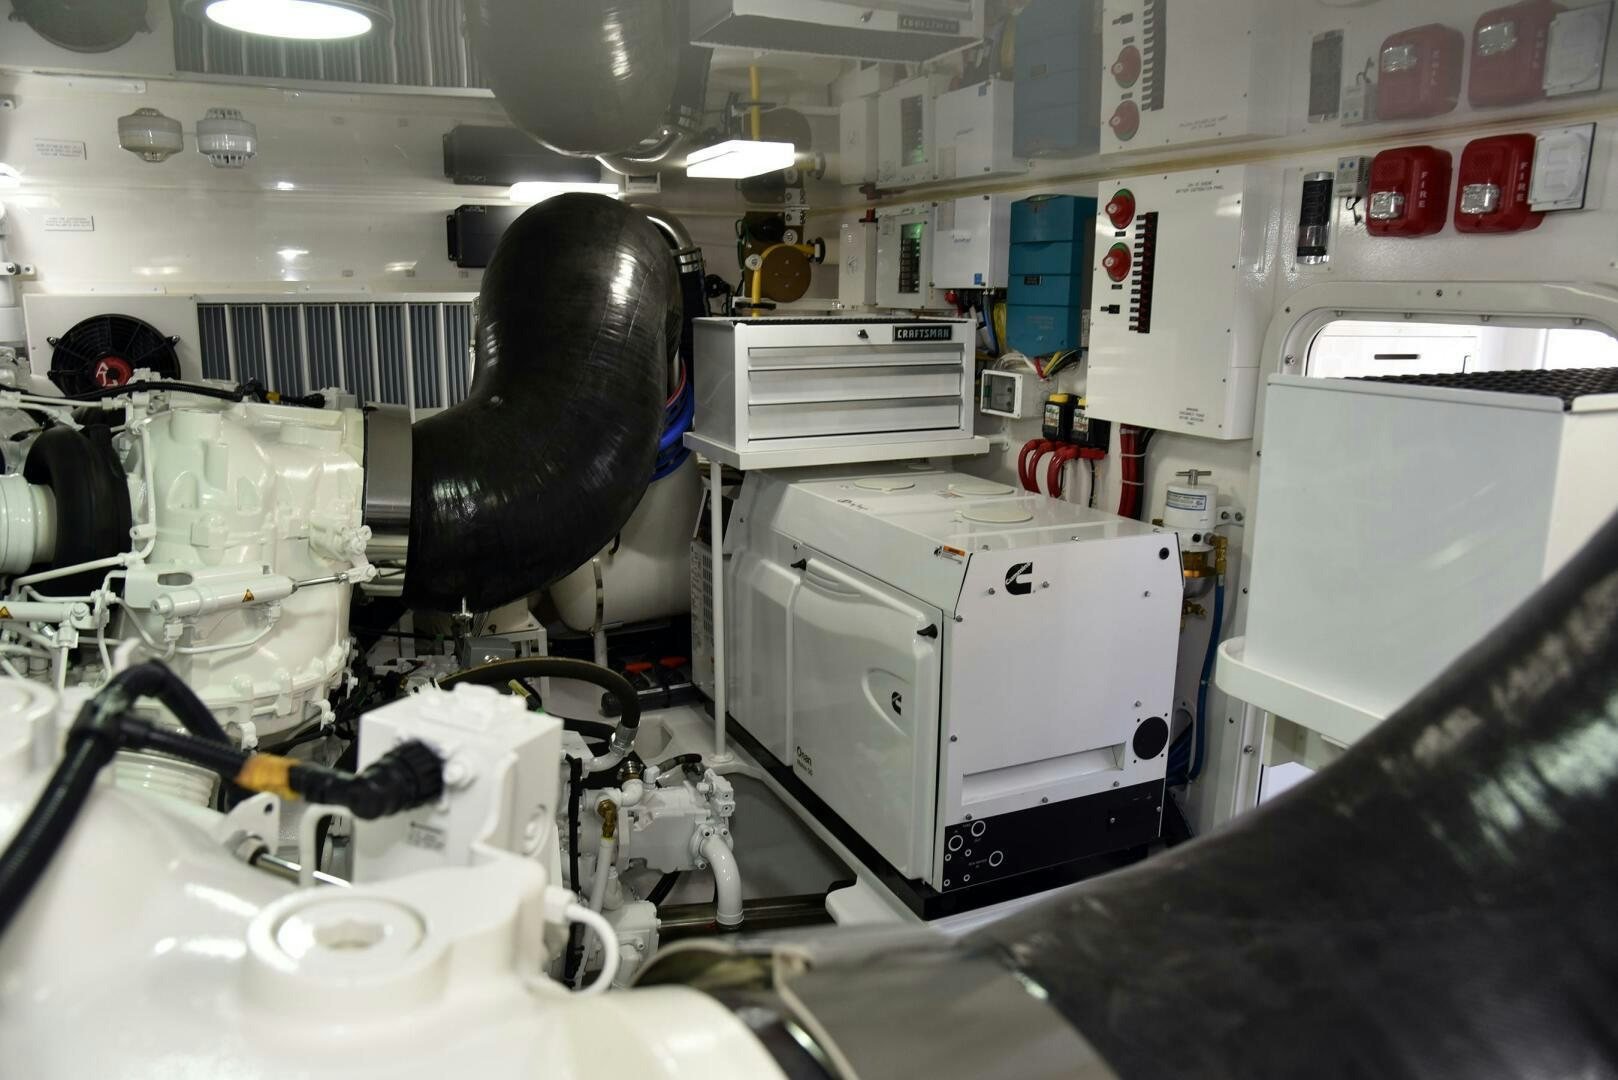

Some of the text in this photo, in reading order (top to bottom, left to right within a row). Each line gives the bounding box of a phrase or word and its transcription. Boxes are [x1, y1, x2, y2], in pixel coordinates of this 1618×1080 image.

[1418, 171, 1429, 209] FIRE
[1516, 162, 1528, 202] FIRE
[896, 328, 950, 339] CRAFTSMAN
